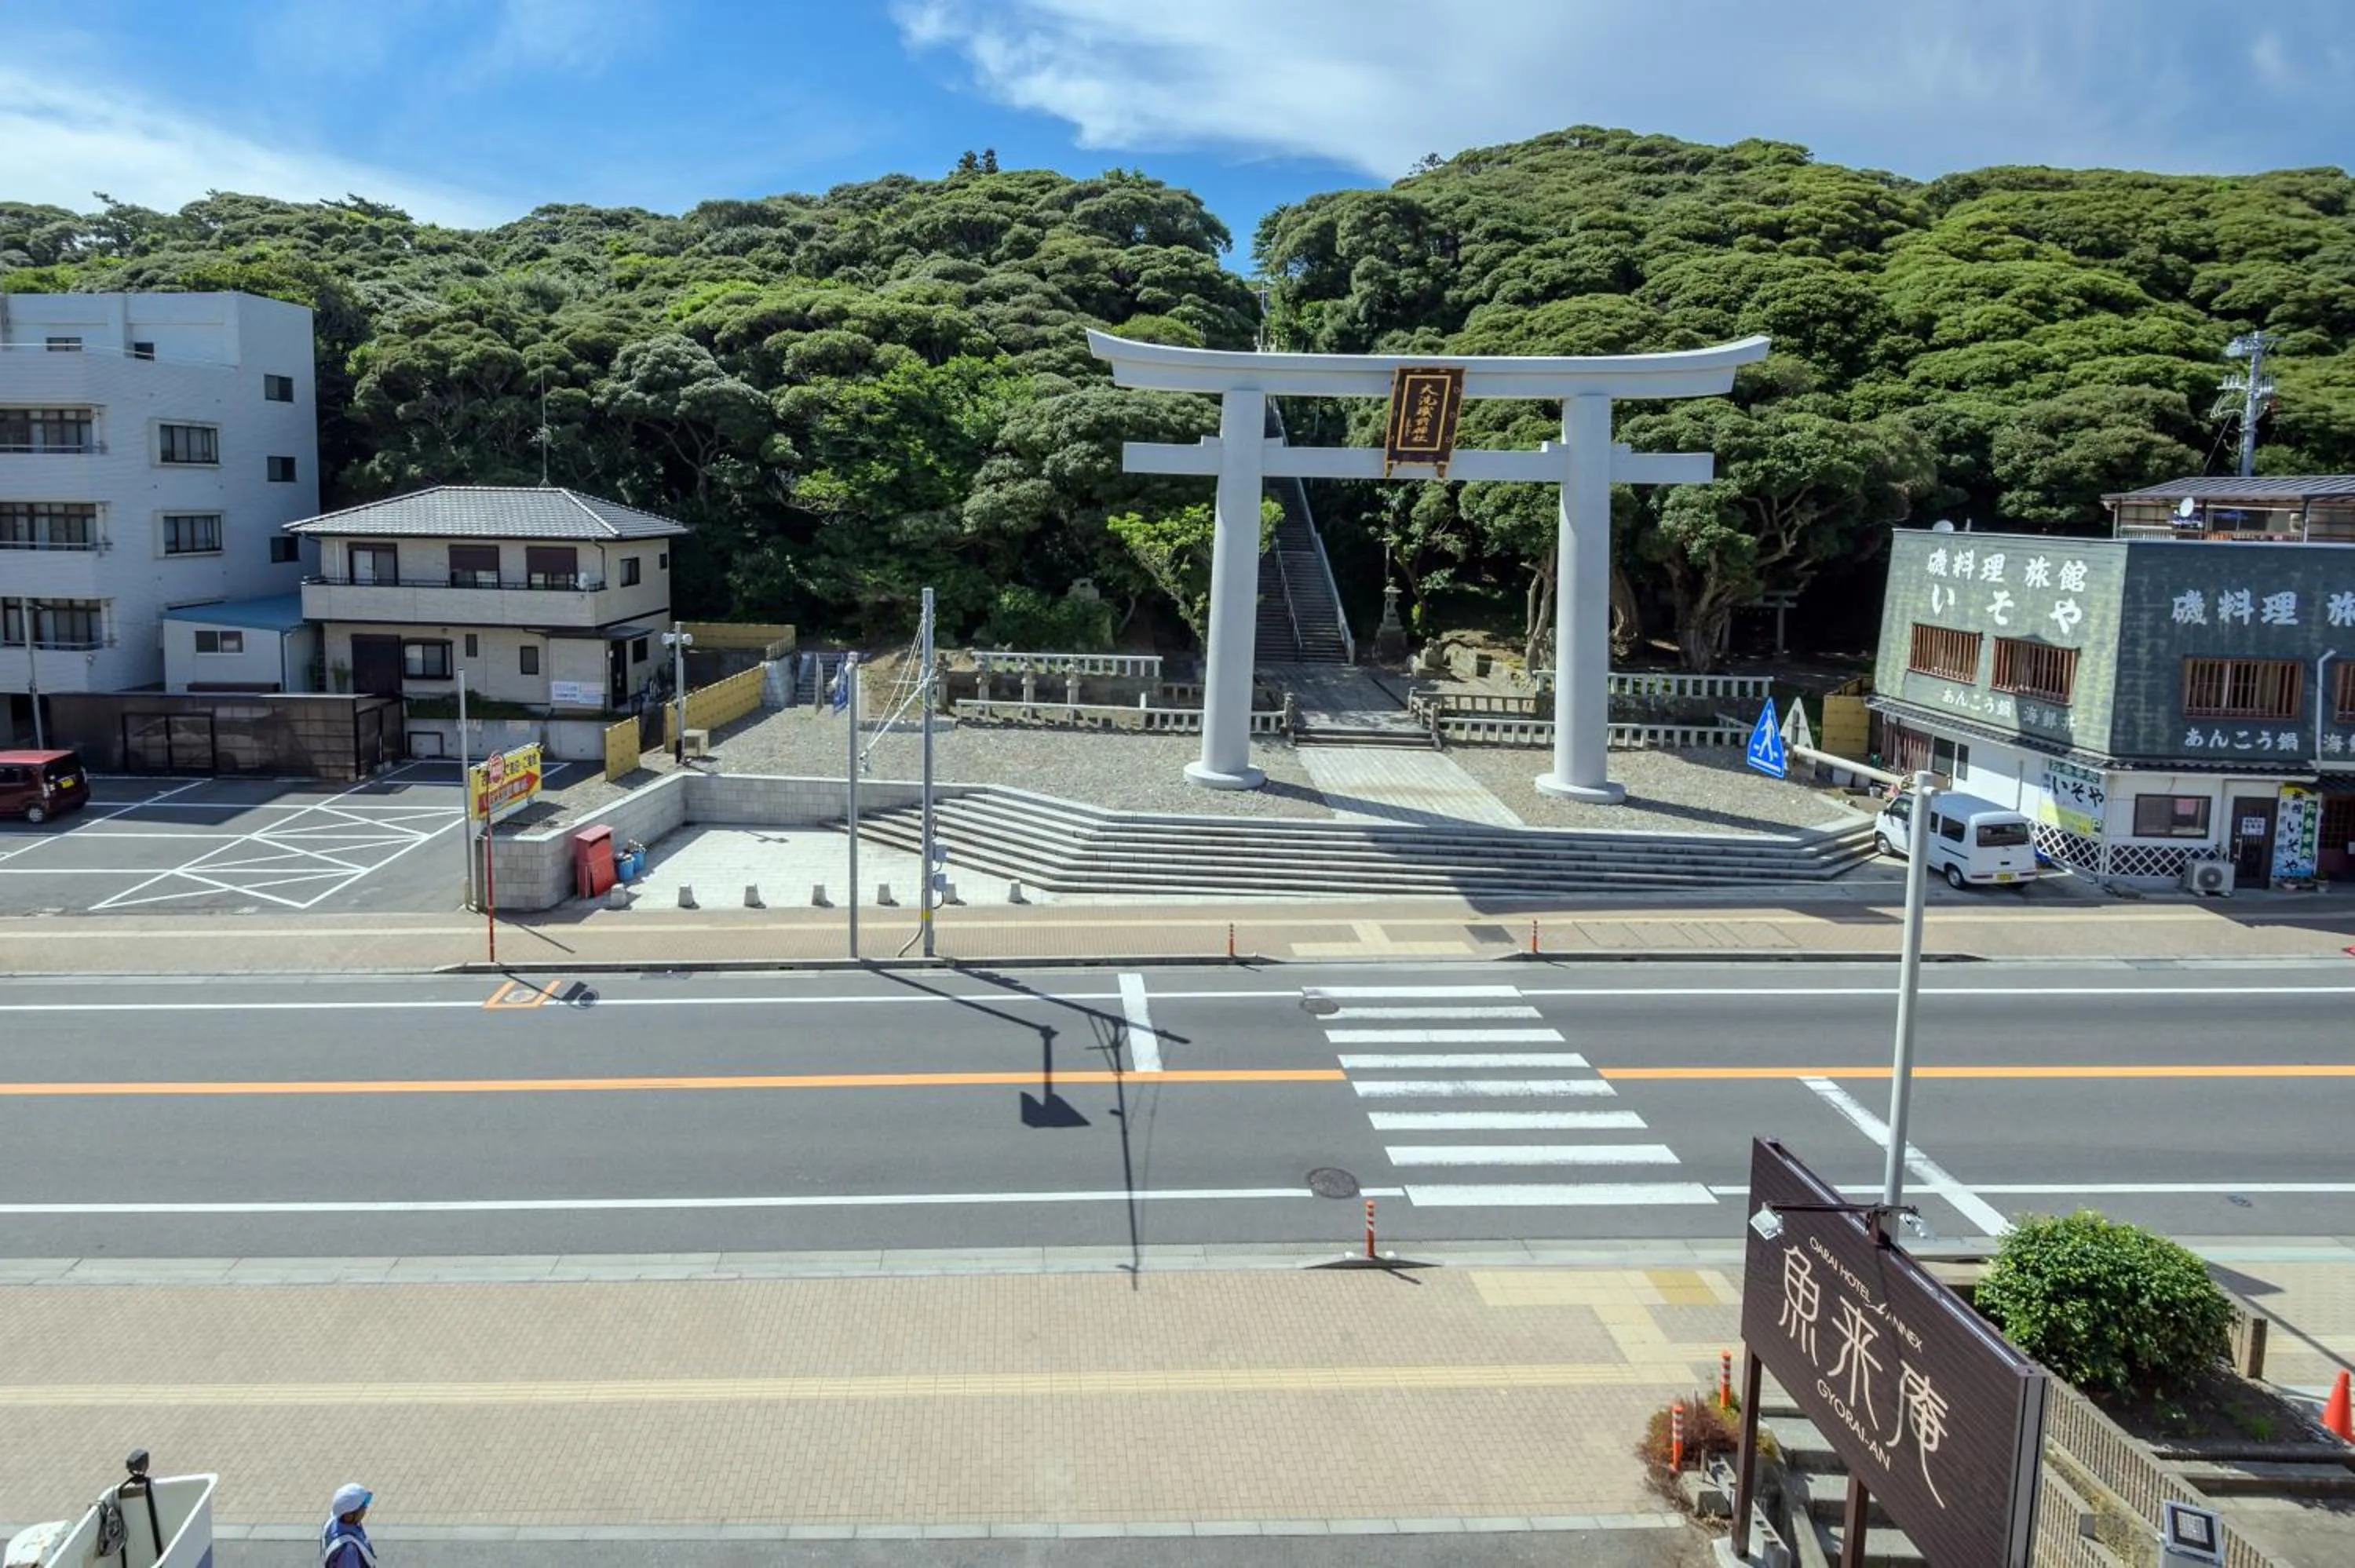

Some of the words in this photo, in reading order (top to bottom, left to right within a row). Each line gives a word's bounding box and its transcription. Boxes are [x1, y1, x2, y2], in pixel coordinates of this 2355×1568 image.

[2024, 554, 2088, 593] 旅館
[1931, 583, 2083, 634] いそや
[2171, 588, 2299, 625] 磯料理
[1941, 687, 2012, 718] あんこう鍋
[2185, 727, 2299, 751] あんこう鍋
[2053, 775, 2105, 808] いそや
[1840, 1264, 1871, 1304] HOTEL
[1816, 1378, 1891, 1472] GYORAI-AN
